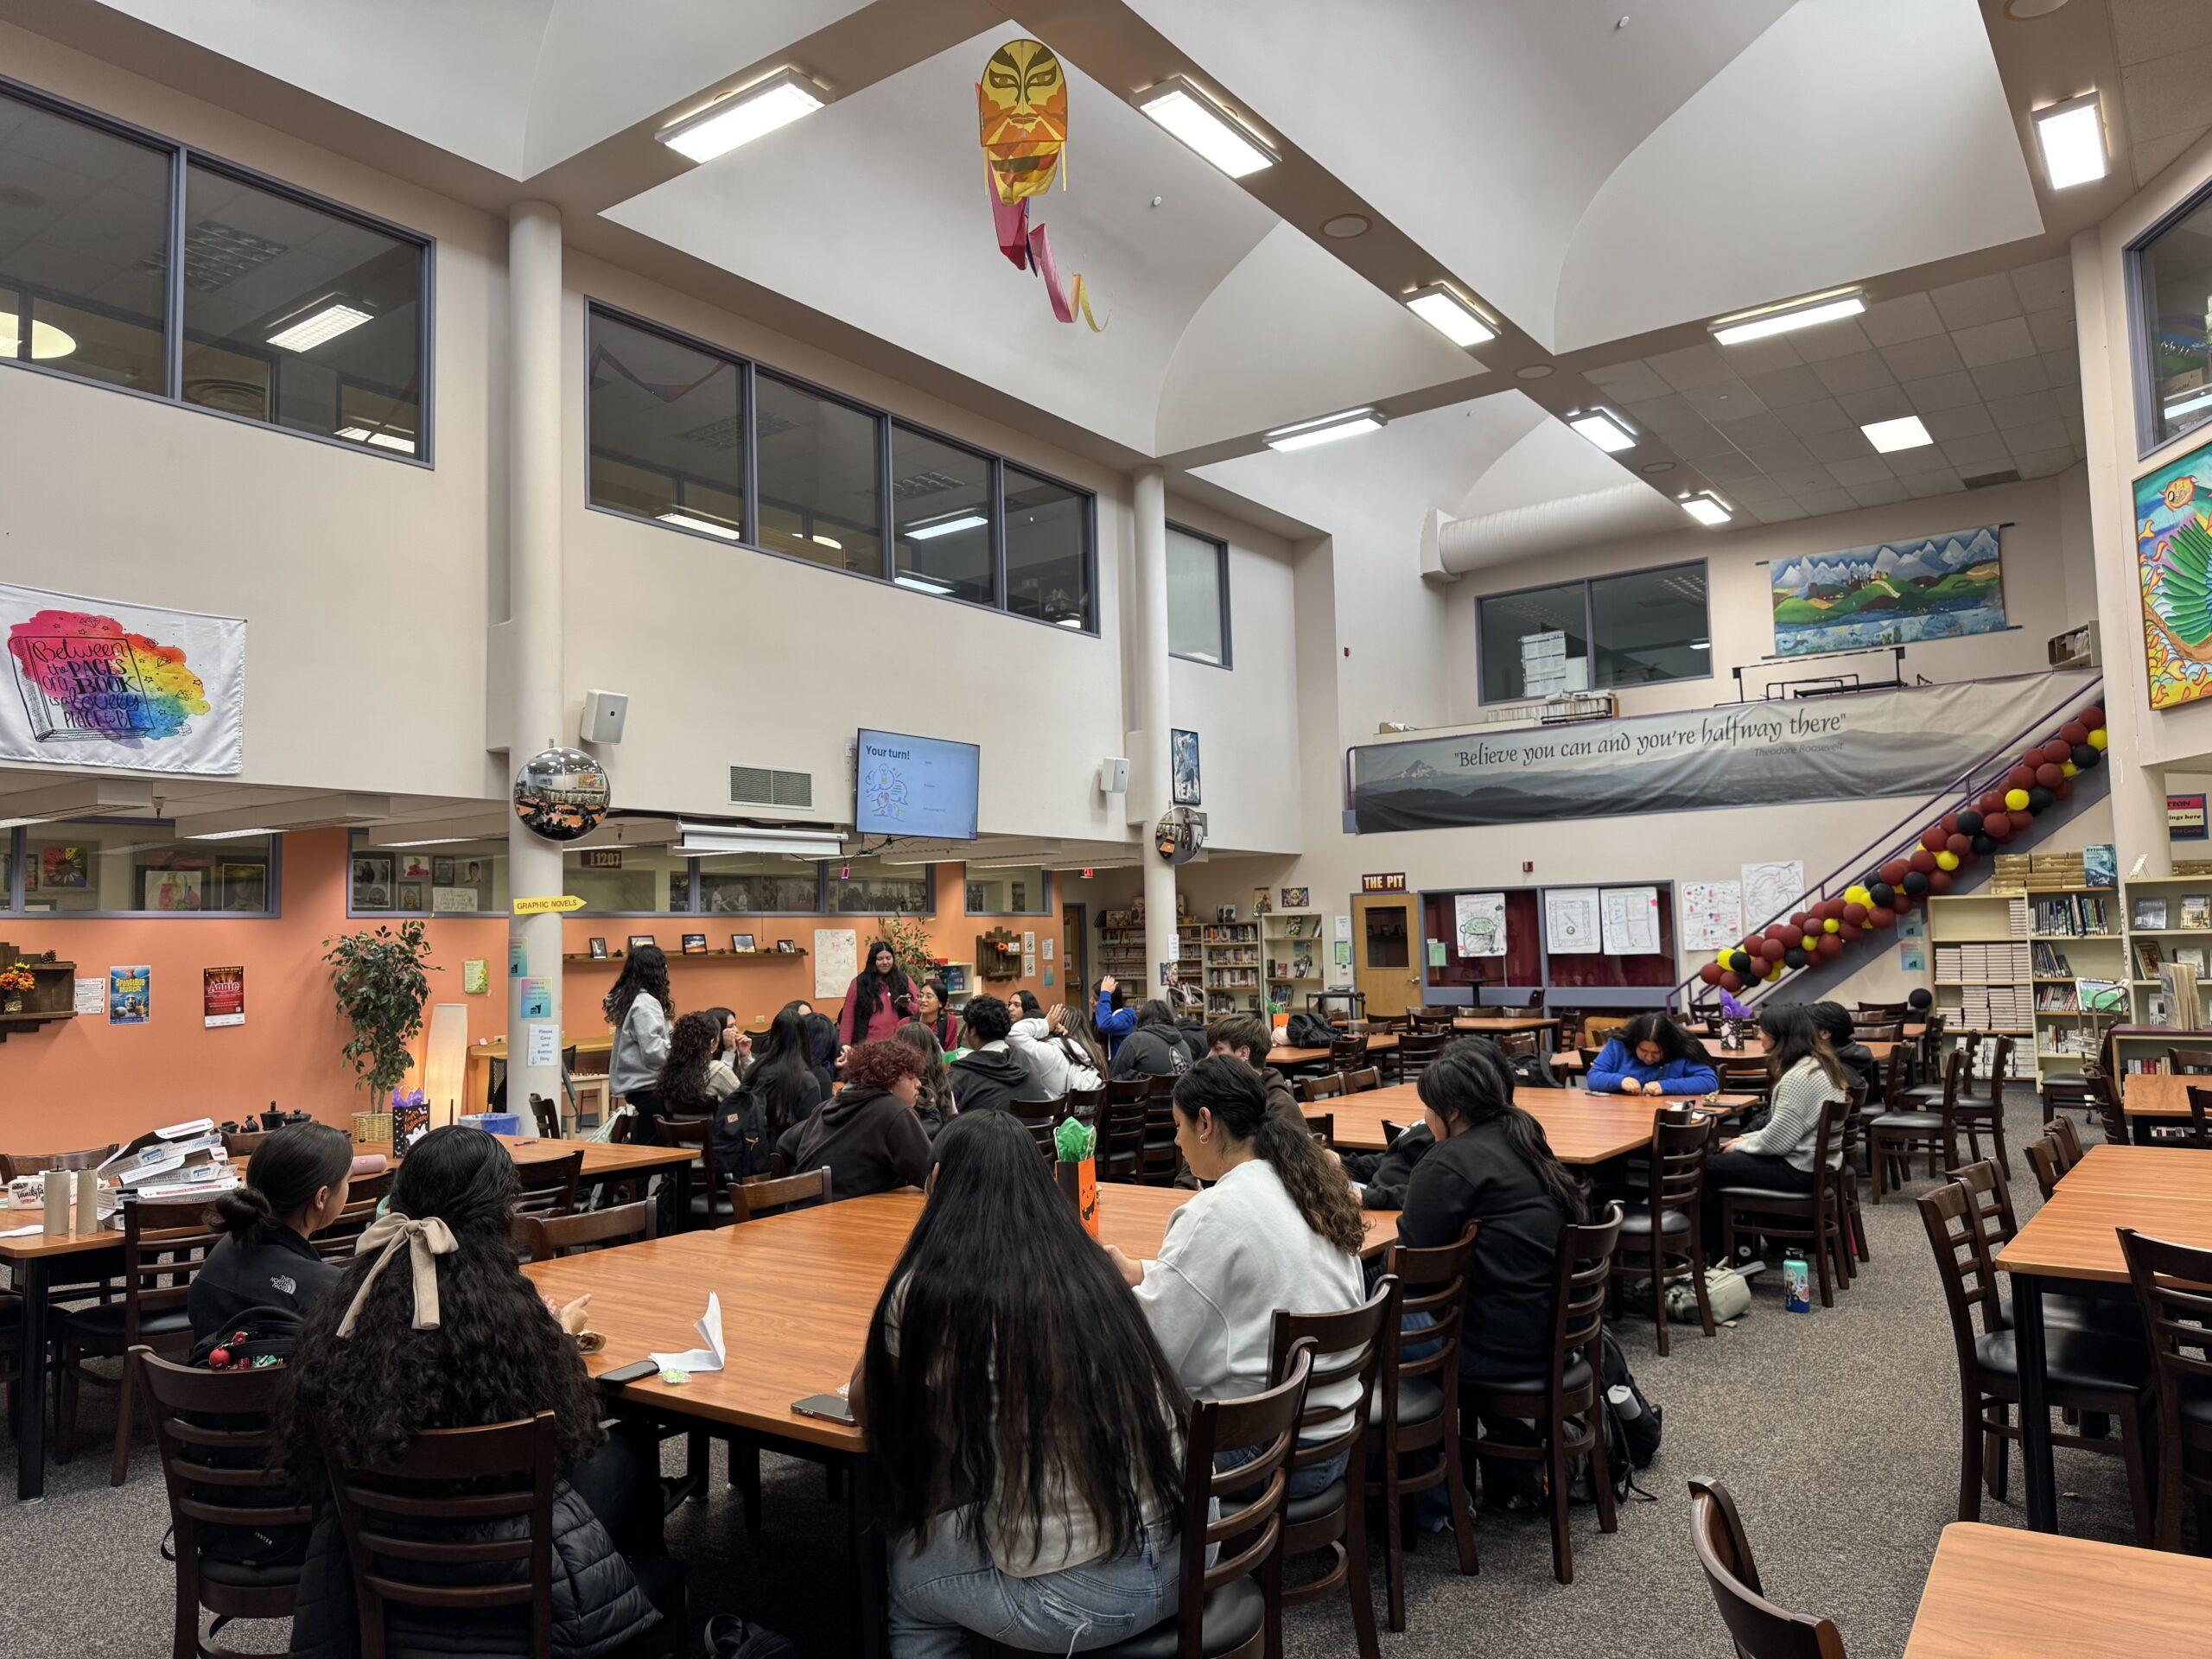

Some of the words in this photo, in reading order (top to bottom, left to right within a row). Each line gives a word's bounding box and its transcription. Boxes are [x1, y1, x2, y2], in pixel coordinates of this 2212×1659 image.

[32, 639, 128, 663] Between
[47, 664, 68, 675] the
[67, 658, 127, 677] PAGES
[73, 676, 142, 695] BOOK
[48, 695, 60, 707] is
[60, 696, 69, 706] a
[69, 686, 141, 712] lovely
[63, 710, 104, 729] PLACE
[104, 712, 116, 723] to
[116, 709, 135, 729] BE
[1454, 742, 1518, 766] "Believe
[1522, 746, 1555, 766] you
[1560, 741, 1592, 757] can
[1598, 733, 1630, 753] and
[1637, 729, 1695, 756] you're
[1701, 715, 1782, 746] halfway
[1790, 708, 1847, 737] there"
[866, 745, 887, 757] Your
[888, 748, 910, 760] turn!
[1755, 746, 1798, 757] Theodore
[1799, 742, 1844, 754] Roosevelt
[595, 852, 620, 866] 1207
[1363, 876, 1383, 889] THE
[1387, 875, 1404, 888] PIT
[517, 901, 550, 910] GRAPHIC
[551, 899, 577, 907] NOVELS
[207, 980, 240, 993] Annie
[270, 1276, 289, 1288] NORTH
[272, 1282, 288, 1294] FACE
